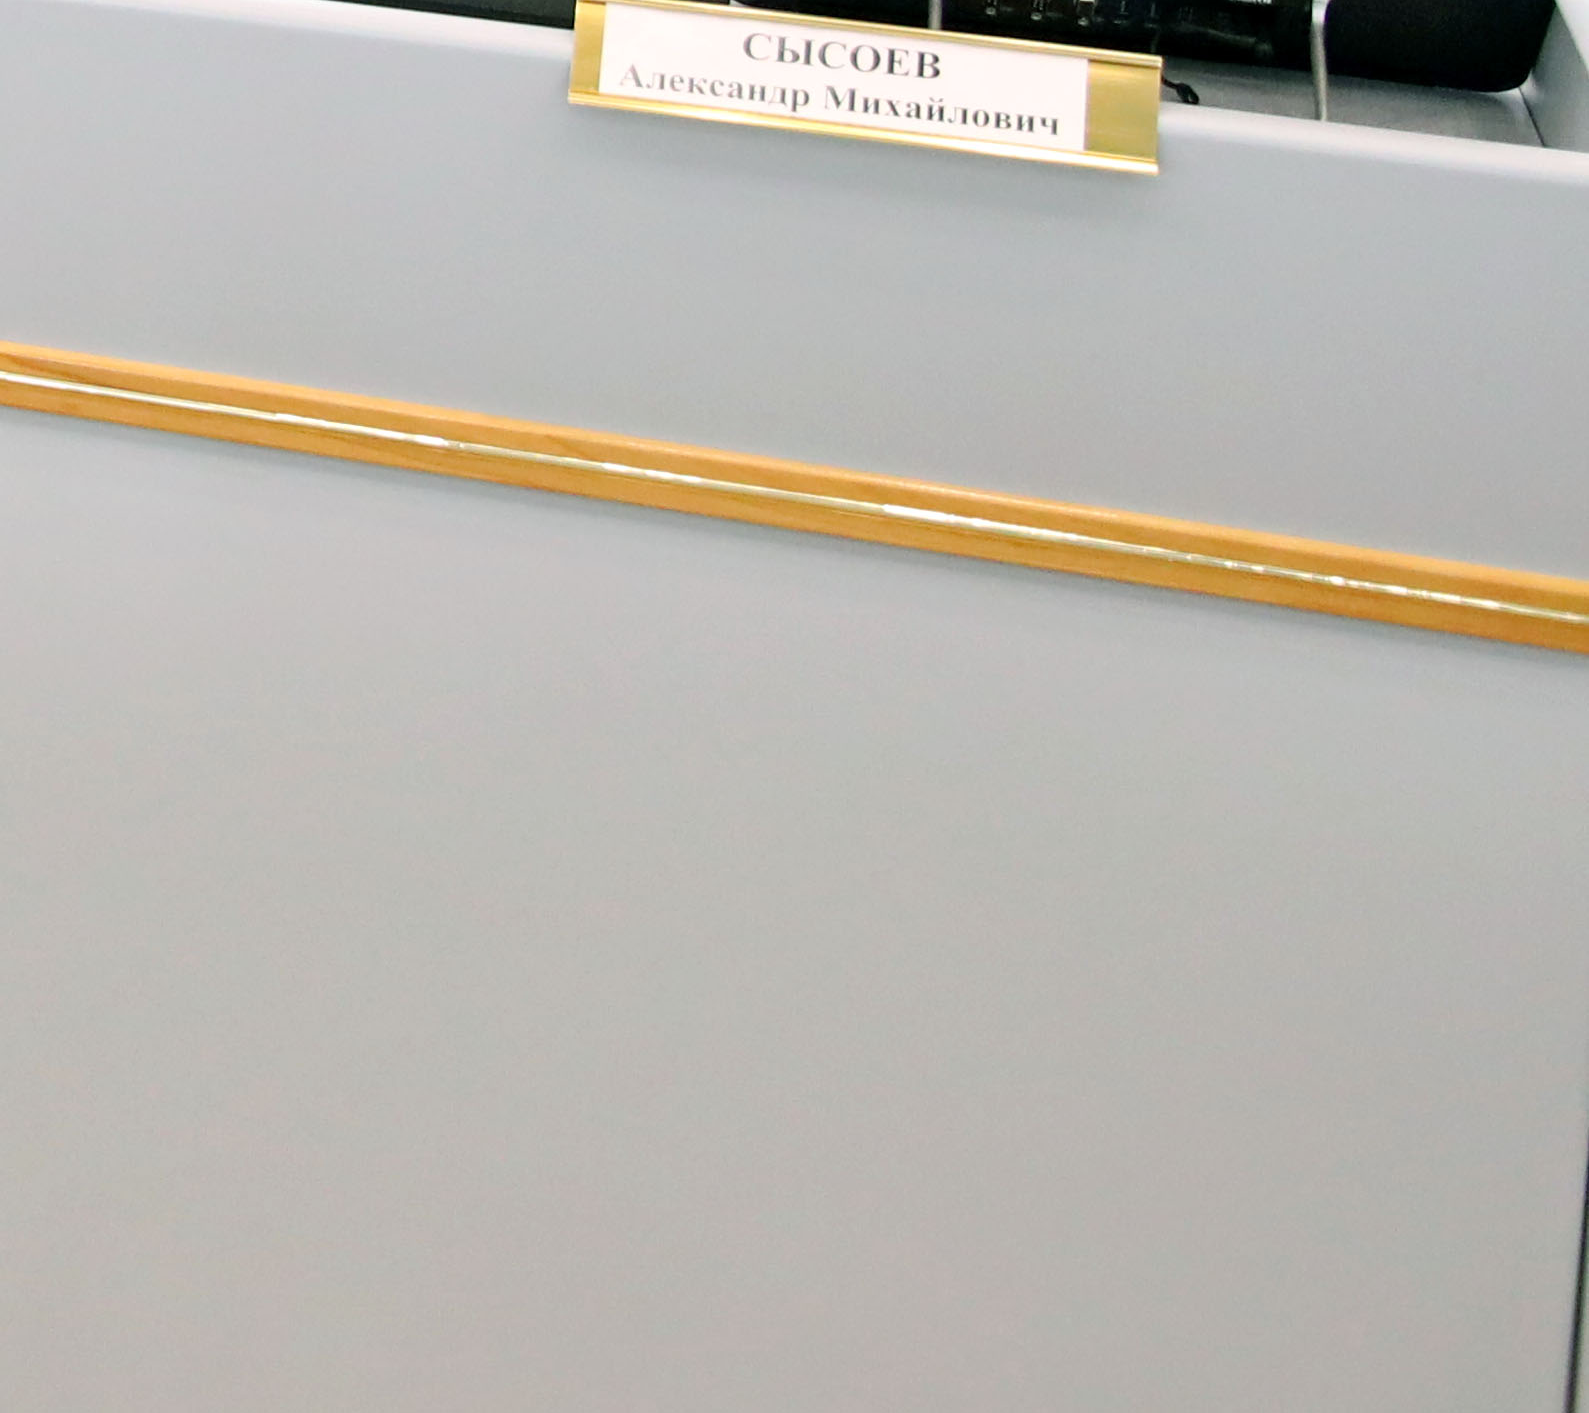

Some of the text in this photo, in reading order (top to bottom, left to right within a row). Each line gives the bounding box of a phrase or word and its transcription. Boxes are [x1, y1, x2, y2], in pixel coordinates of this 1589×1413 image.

[743, 32, 941, 80] СЫСОЕВ
[618, 63, 1060, 136] Александр Михайлович
